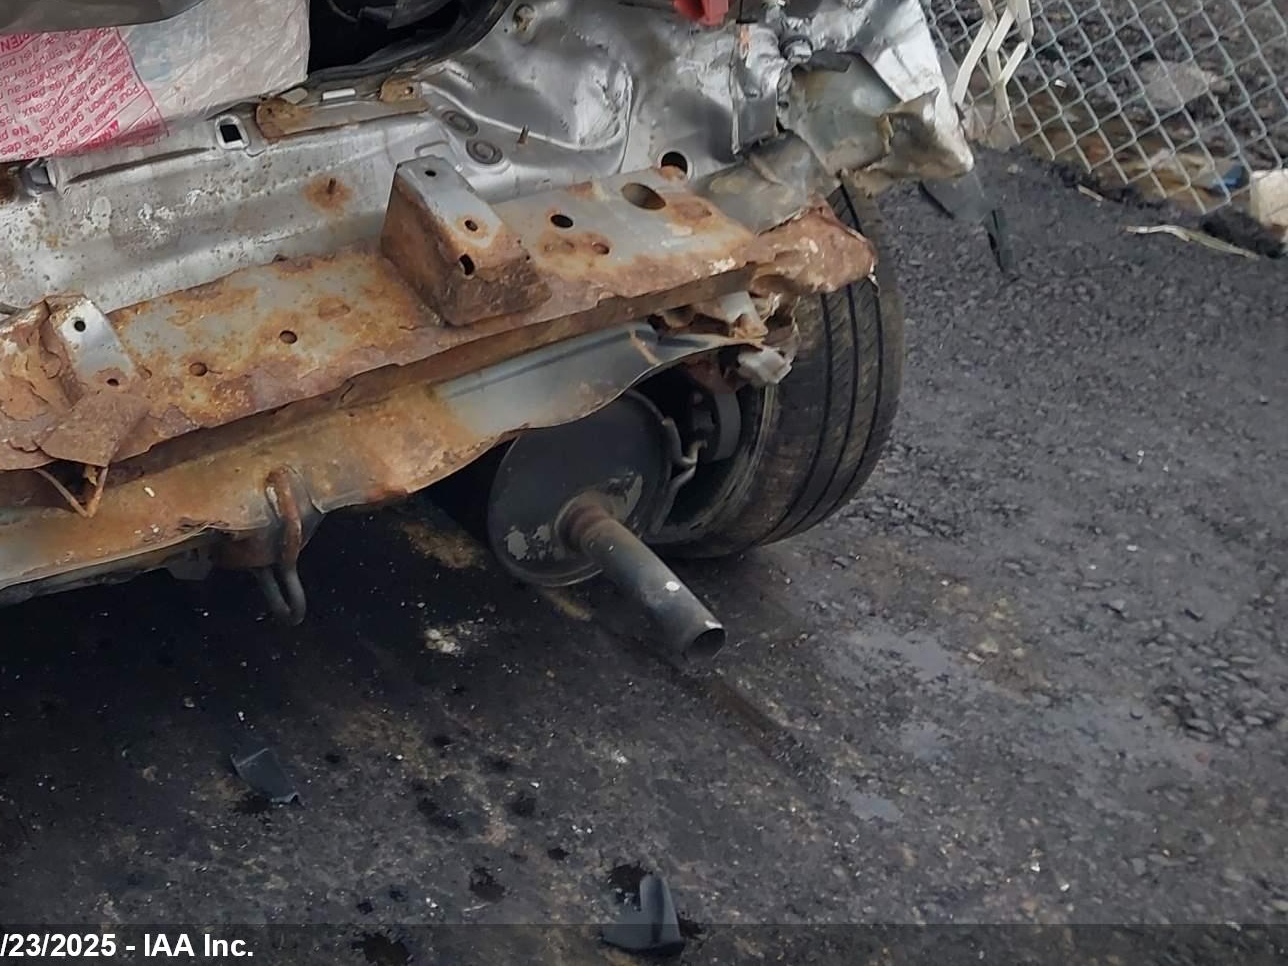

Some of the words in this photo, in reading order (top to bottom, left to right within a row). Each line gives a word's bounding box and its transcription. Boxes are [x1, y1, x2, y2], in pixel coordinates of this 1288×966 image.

[7, 85, 21, 96] au
[120, 83, 140, 104] Pour
[0, 114, 16, 126] les
[58, 112, 70, 124] de
[12, 124, 29, 136] Ne
[56, 112, 84, 138] garder
[79, 123, 93, 137] les
[0, 142, 22, 156] des
[42, 139, 54, 150] ce
